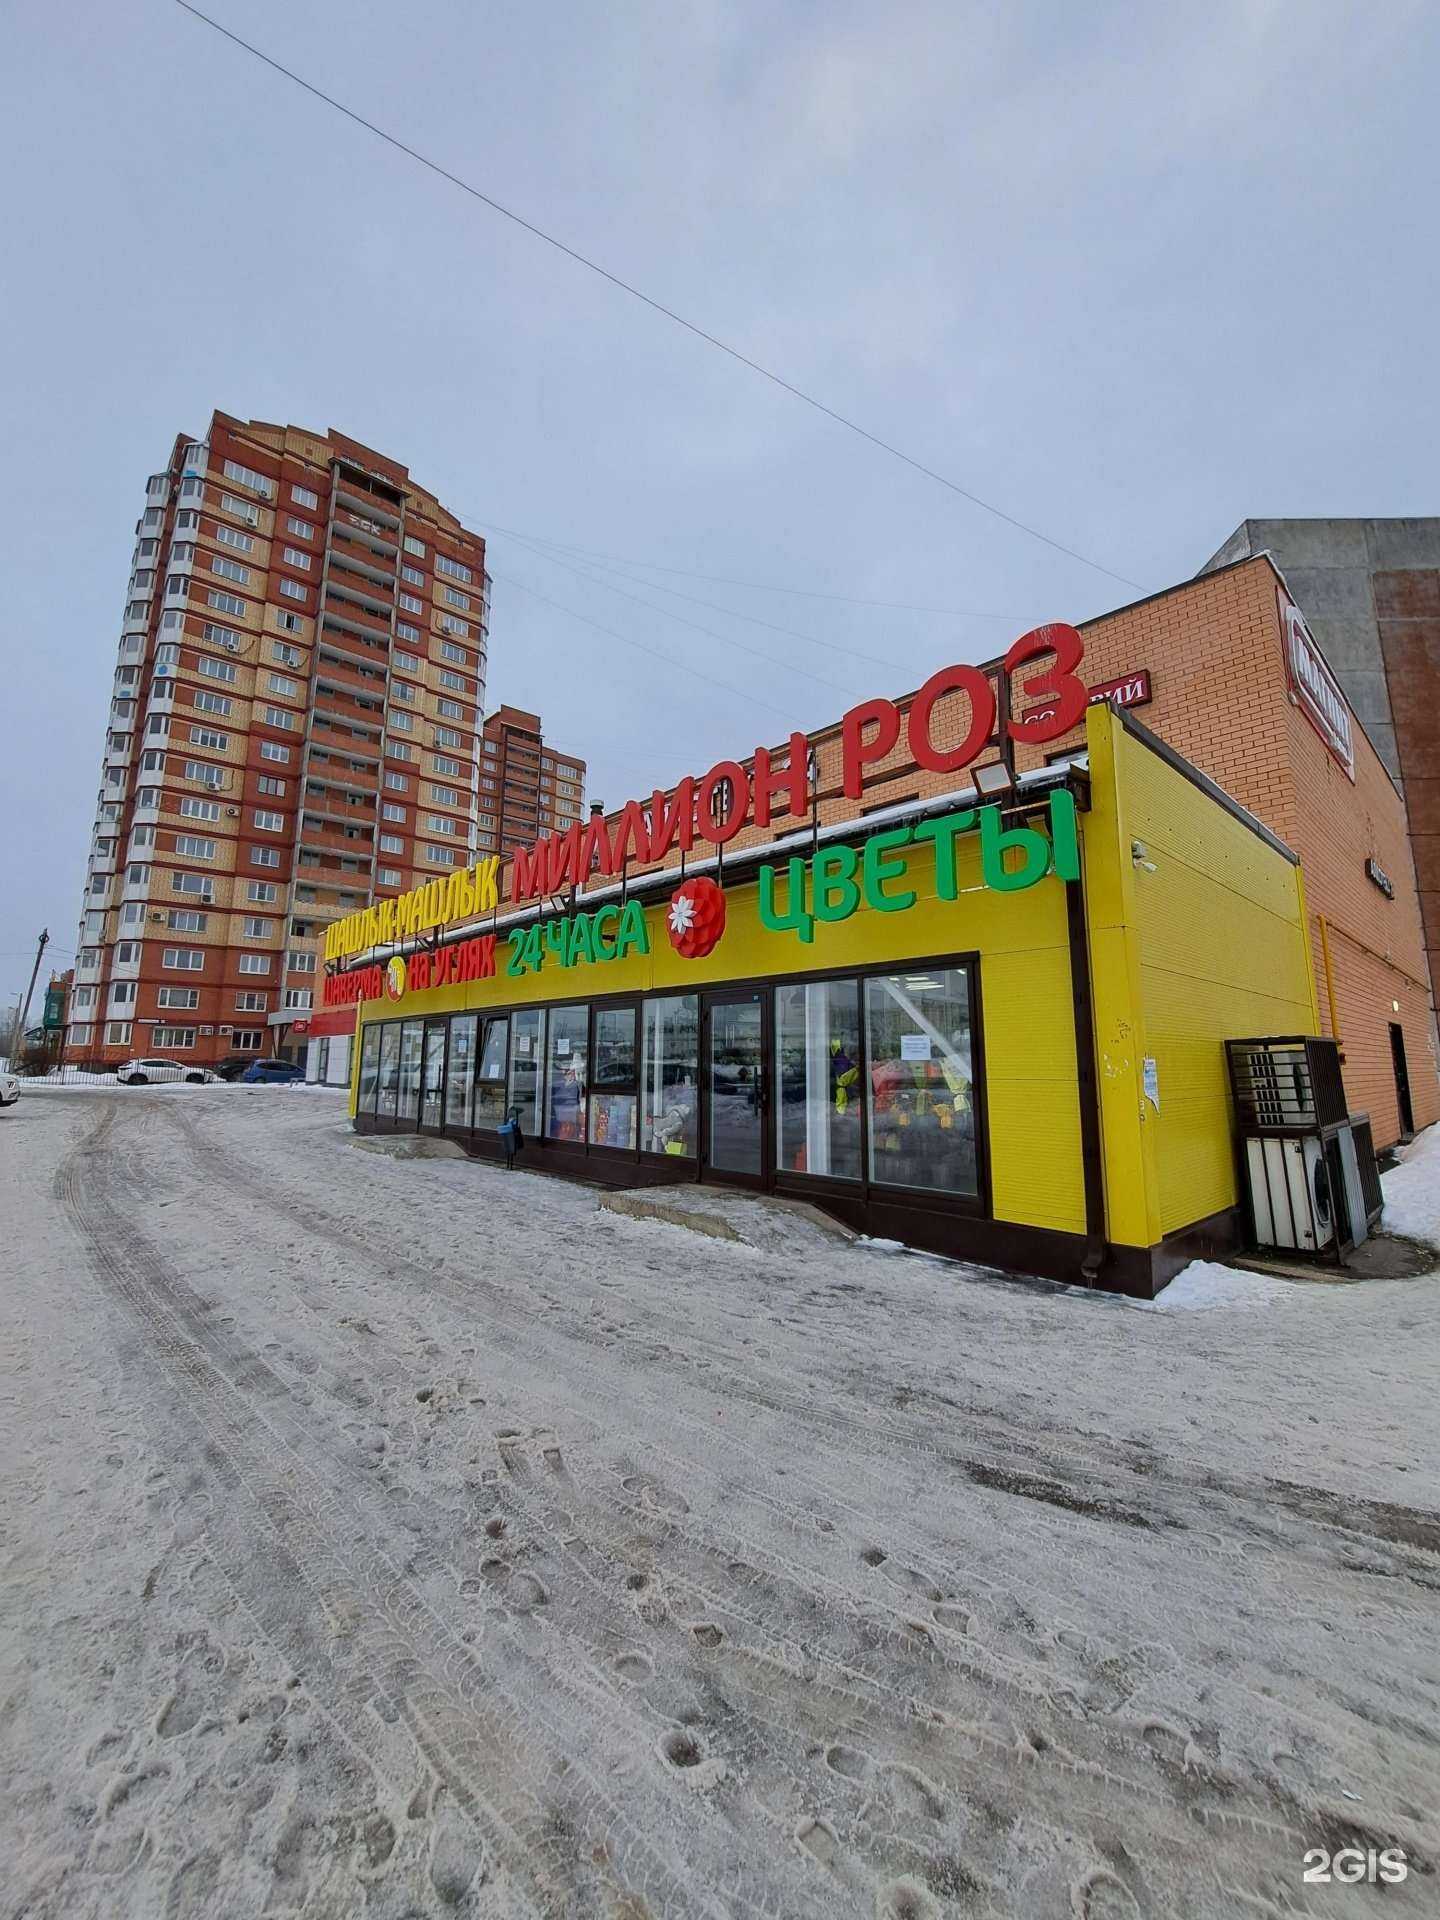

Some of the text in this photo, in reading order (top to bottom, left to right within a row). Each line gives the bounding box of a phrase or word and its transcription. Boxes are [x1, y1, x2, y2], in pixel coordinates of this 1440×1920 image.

[511, 732, 808, 904] МИЛЛИОН
[842, 622, 1088, 799] РОЗ
[759, 789, 1080, 943] ЦВЕТЫ
[435, 934, 497, 987] УГЛЯХ
[507, 900, 650, 976] 24 ЧАСА
